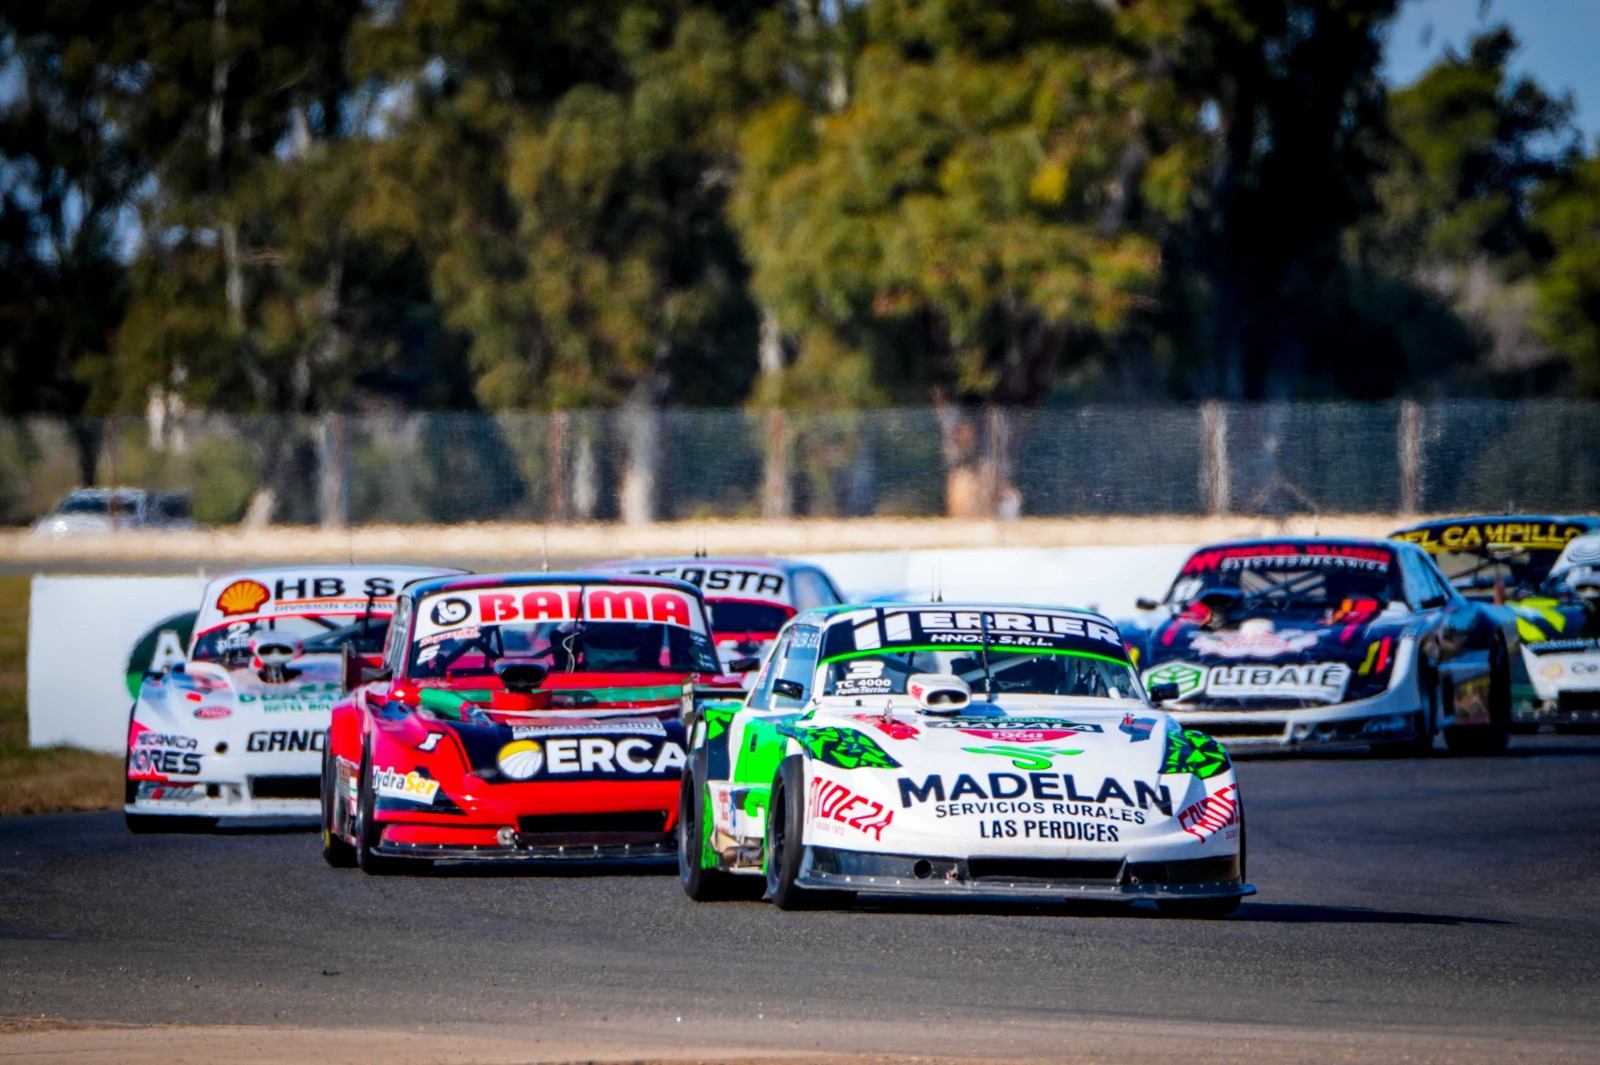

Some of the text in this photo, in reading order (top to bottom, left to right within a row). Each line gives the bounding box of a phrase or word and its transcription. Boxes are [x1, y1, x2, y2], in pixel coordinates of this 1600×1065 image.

[275, 579, 346, 600] HB
[478, 591, 691, 627] BAIMA
[998, 636, 1053, 647] S.R.L.
[846, 661, 885, 680] 3
[858, 679, 892, 687] 4000
[417, 732, 443, 751] 5
[897, 773, 1172, 817] MADELAN
[935, 800, 1146, 825] SERVICIOS RURALES
[979, 820, 1120, 842] LAS PERDICES
